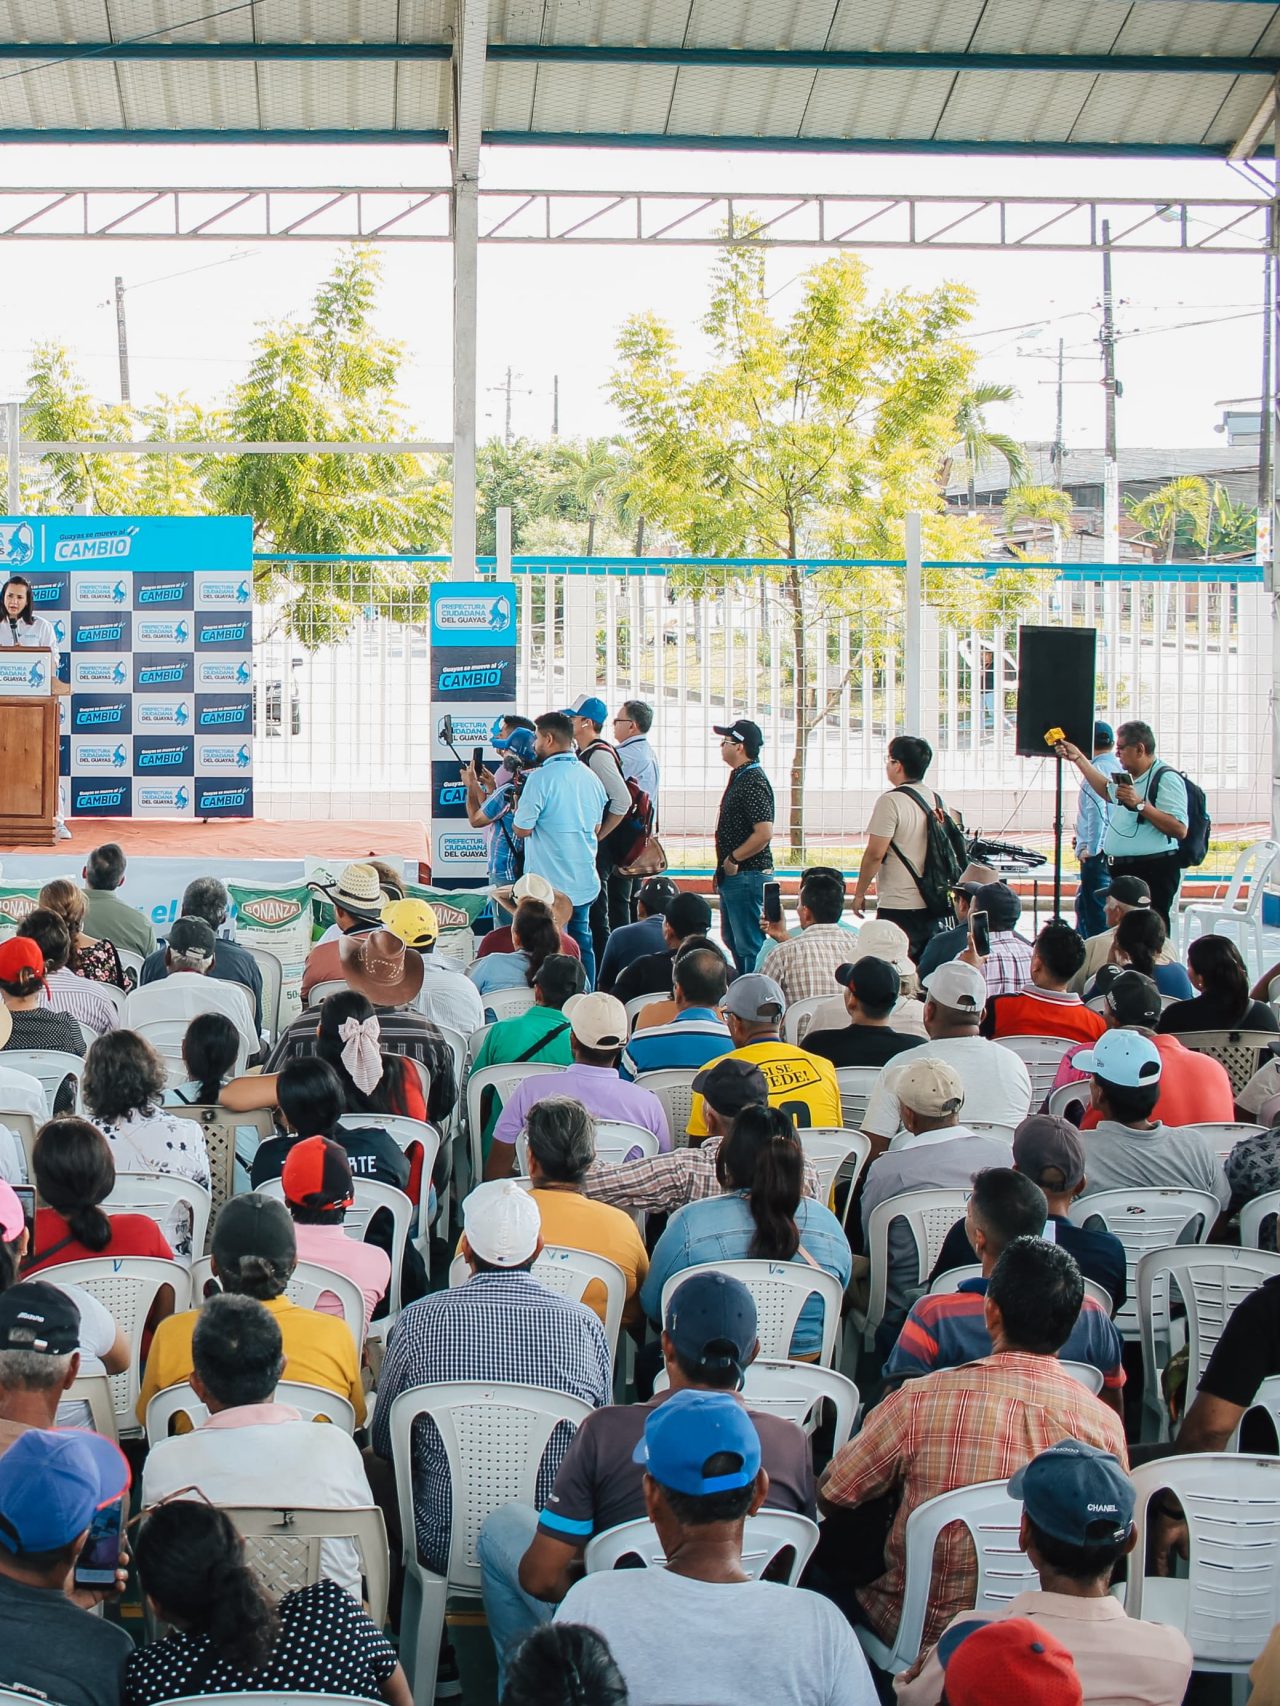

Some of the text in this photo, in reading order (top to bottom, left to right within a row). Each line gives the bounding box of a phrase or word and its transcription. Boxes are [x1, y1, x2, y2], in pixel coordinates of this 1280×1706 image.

[60, 533, 85, 541] Guayas
[58, 540, 128, 558] CAMBIO
[33, 590, 57, 600] MBIO
[141, 590, 181, 601] CAMBIO
[80, 629, 118, 641] CAMBIO
[202, 629, 242, 641] CAMBIO
[141, 671, 180, 682] CAMBIO
[442, 672, 497, 688] CAMBIO
[80, 711, 118, 722] CAMBIO
[202, 711, 242, 722] CAMBIO
[141, 753, 180, 765] CAMBIO
[80, 794, 118, 806] CAMBIO
[202, 794, 242, 806] CAMBIO
[151, 900, 177, 924] el
[245, 902, 298, 920] BONANZA
[436, 908, 464, 924] ANZA
[776, 1064, 792, 1074] SE
[770, 1071, 810, 1087] EDE!
[1087, 1504, 1118, 1512] CHANEL
